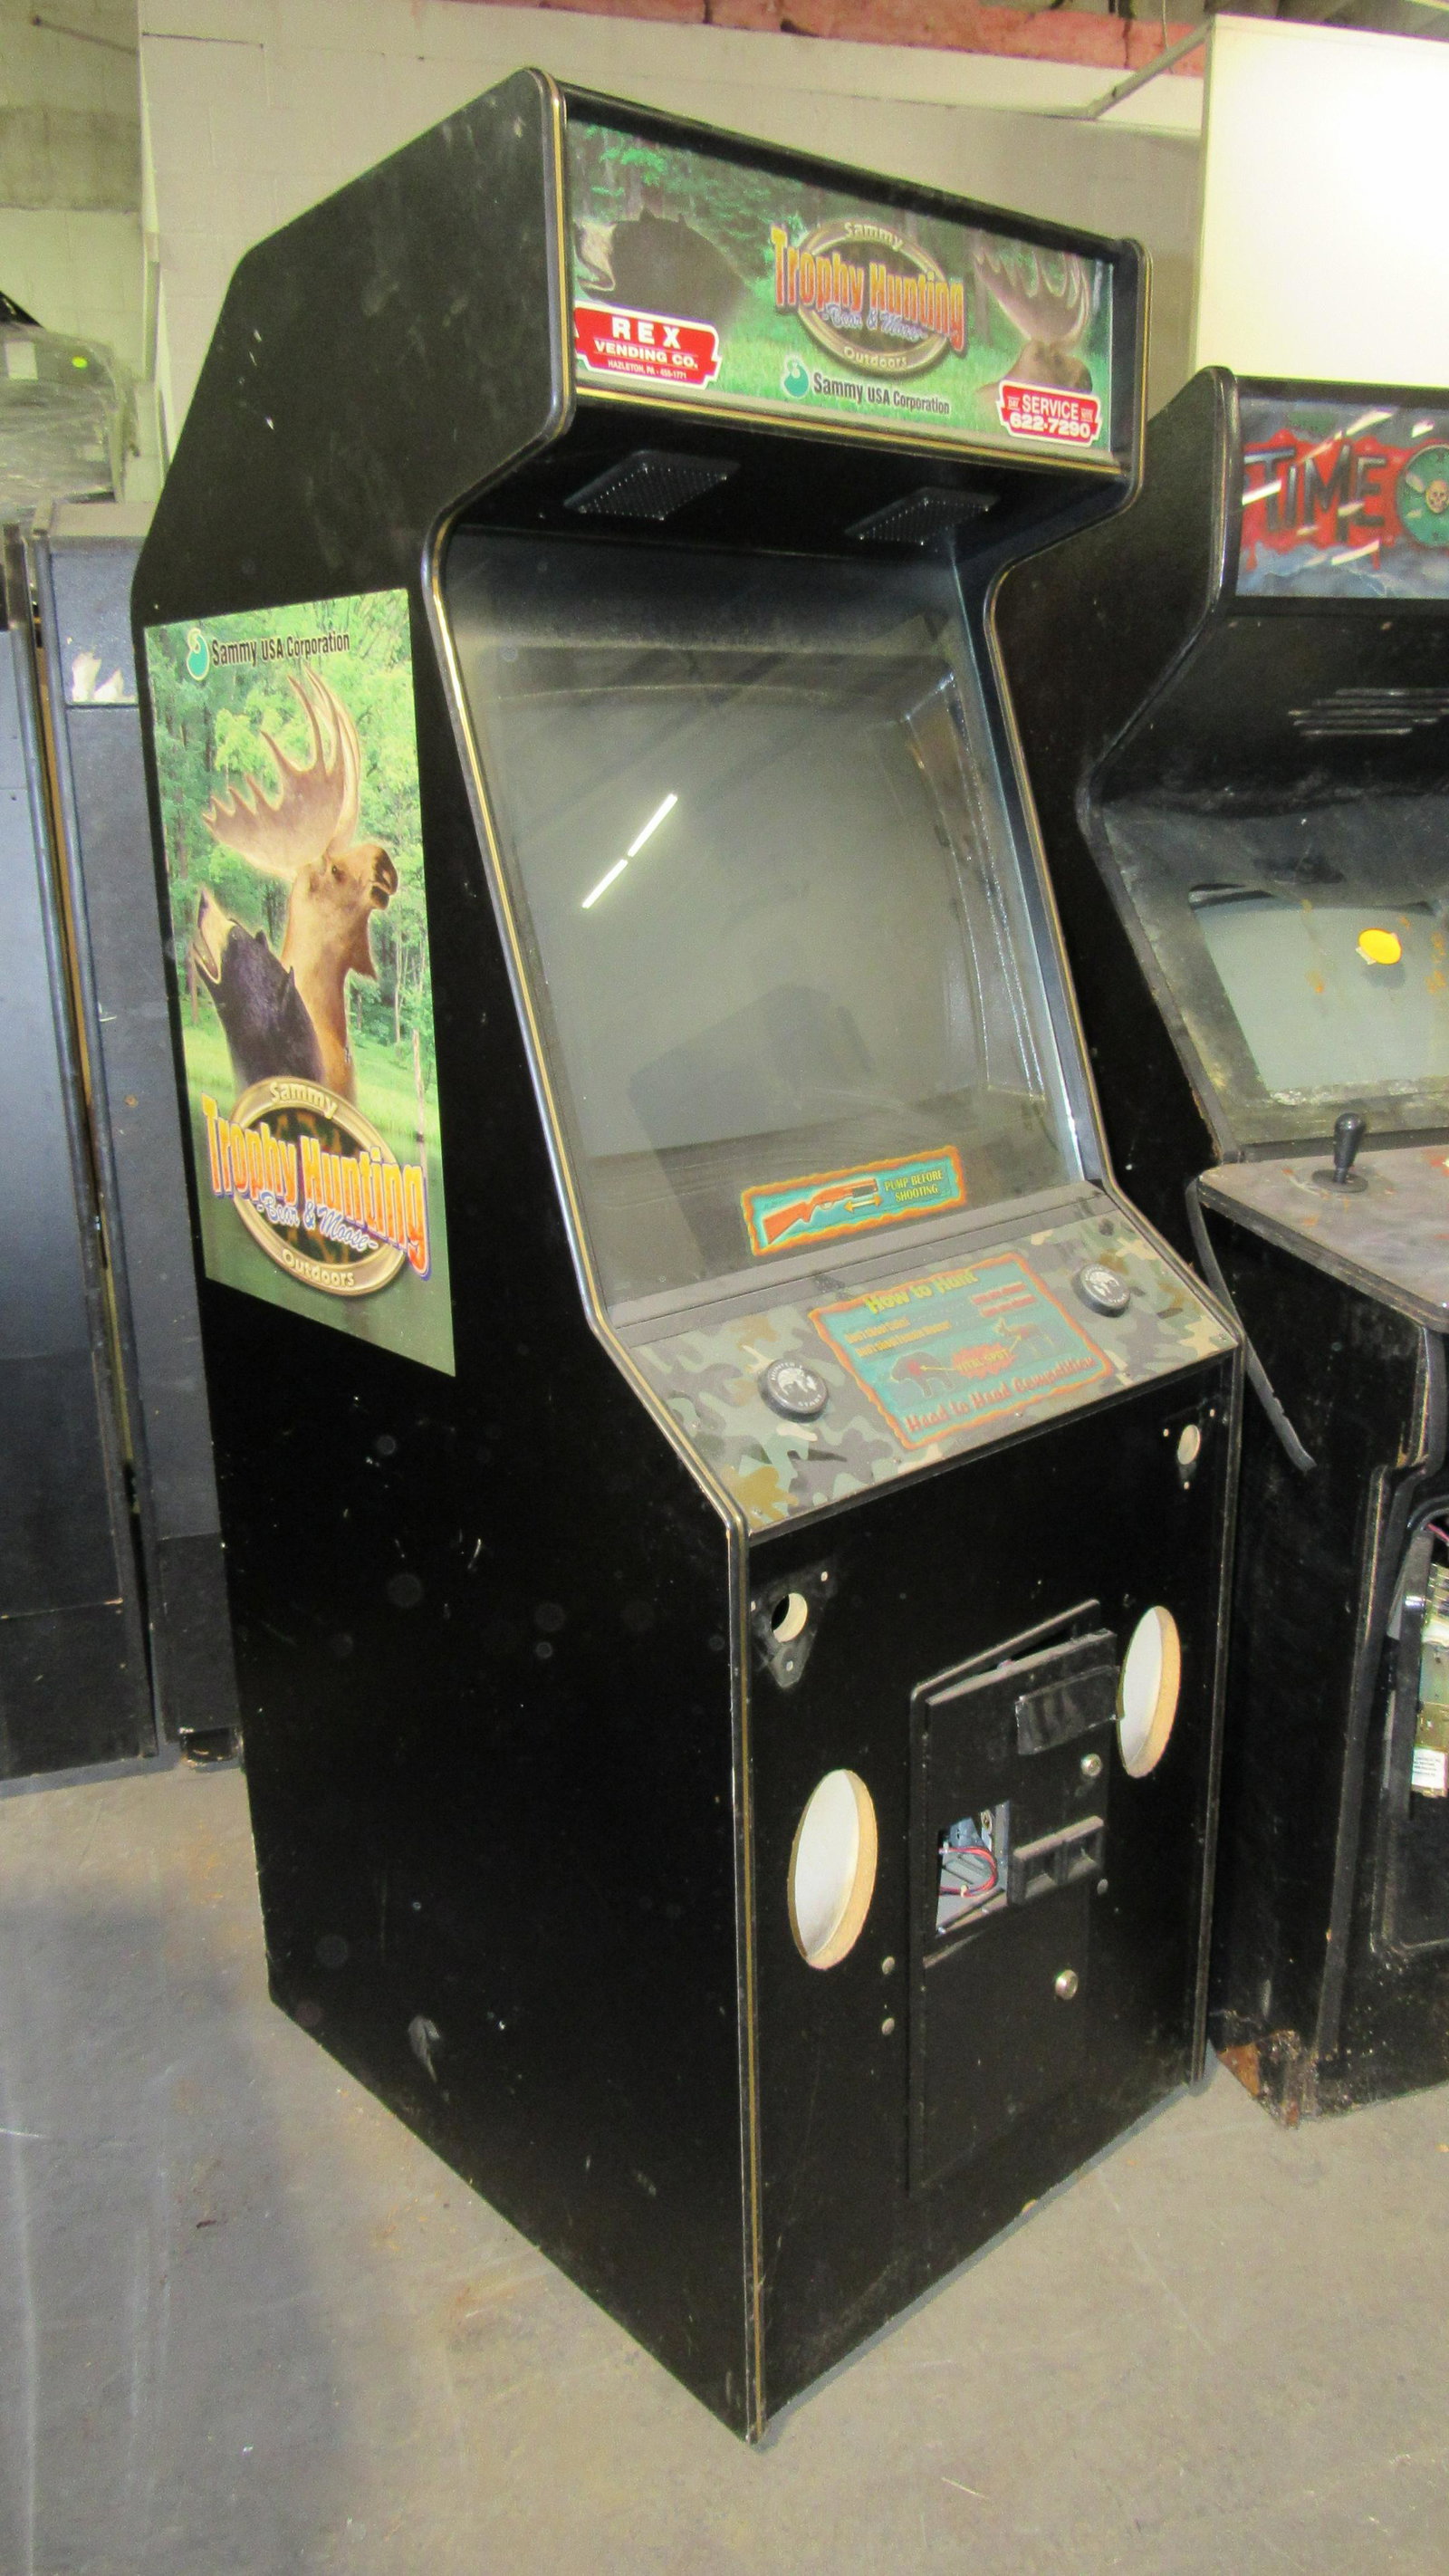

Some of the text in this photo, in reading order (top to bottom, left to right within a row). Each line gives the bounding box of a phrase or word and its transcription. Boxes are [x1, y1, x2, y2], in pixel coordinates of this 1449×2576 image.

[844, 222, 904, 252] Sammy
[771, 225, 964, 351] Trophy Hunting
[611, 316, 681, 350] REX
[867, 308, 878, 331] &
[593, 339, 699, 369] VENDING CO.
[646, 365, 656, 375] PA
[843, 346, 907, 369] Outdoors
[813, 371, 950, 415] Sammy USA Corporation
[1022, 393, 1080, 420] SERVICE
[1243, 444, 1387, 543] TIME
[212, 633, 350, 667] Sammy USA Corporation
[270, 1082, 339, 1120] Sammy
[201, 1093, 430, 1278] Trophy Hunting
[884, 1169, 943, 1192] PUMP BEFORE
[895, 1183, 939, 1203] SHOOTING
[302, 1197, 316, 1230] &
[282, 1248, 355, 1287] Outdoors
[865, 1293, 910, 1315] How
[910, 1285, 933, 1299] to
[932, 1269, 979, 1294] Hunt
[950, 1401, 970, 1415] to
